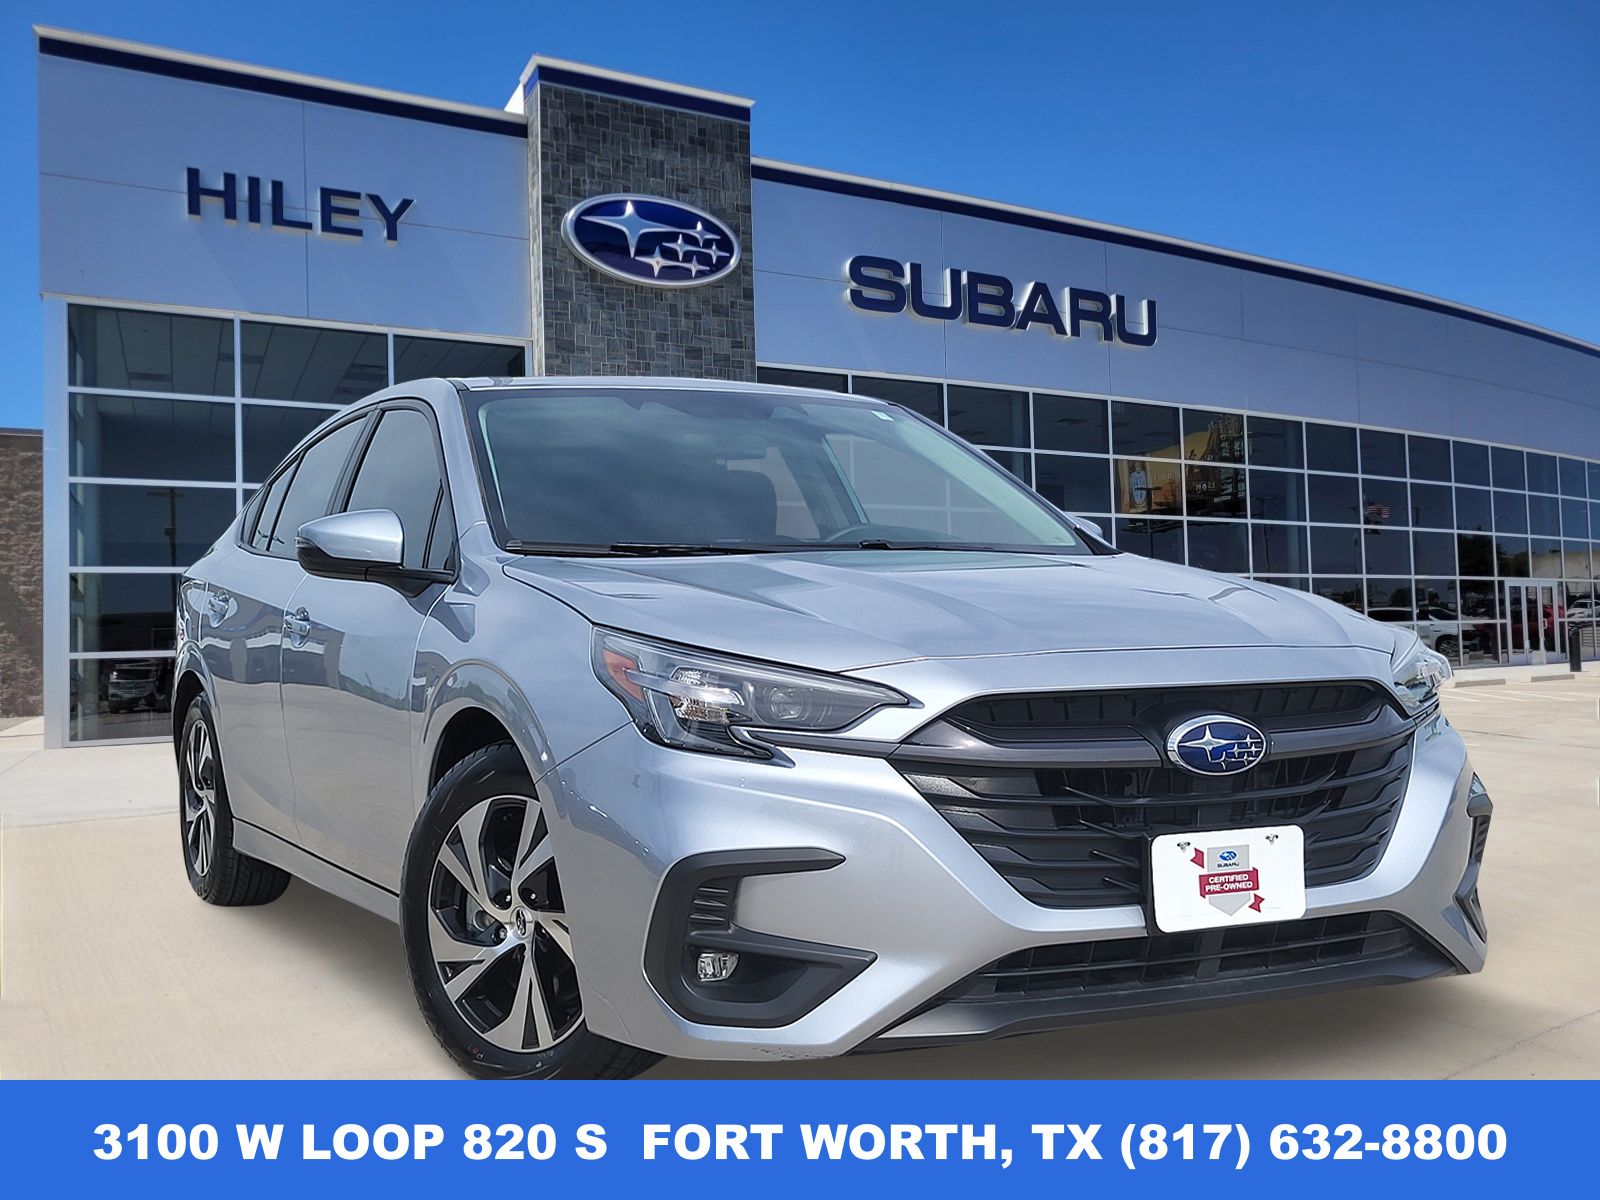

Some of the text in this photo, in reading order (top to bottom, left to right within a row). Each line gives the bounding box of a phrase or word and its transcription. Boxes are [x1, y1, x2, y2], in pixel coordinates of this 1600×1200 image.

[186, 166, 415, 242] HILEY
[847, 254, 1158, 348] SUBARU
[1205, 881, 1253, 892] PRE-OWNED
[1208, 874, 1249, 883] CERTIFIED
